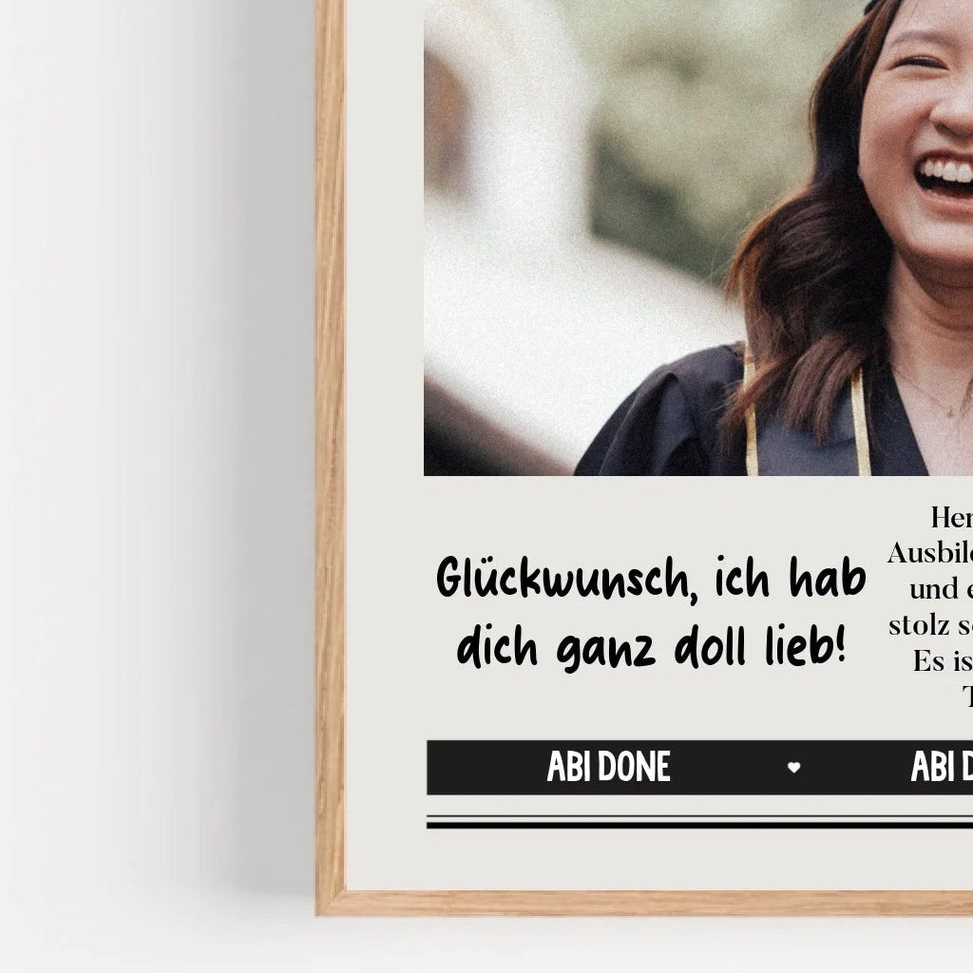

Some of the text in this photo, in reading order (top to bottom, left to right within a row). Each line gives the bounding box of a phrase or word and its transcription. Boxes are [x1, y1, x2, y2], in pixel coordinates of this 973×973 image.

[436, 554, 867, 607] Glückwunsch, ich hab
[910, 575, 959, 600] und
[888, 611, 950, 636] stolz
[456, 622, 846, 675] dich ganz doll lieb!
[913, 649, 945, 672] Es
[546, 750, 671, 782] ABI DONE
[910, 750, 955, 782] ABI
